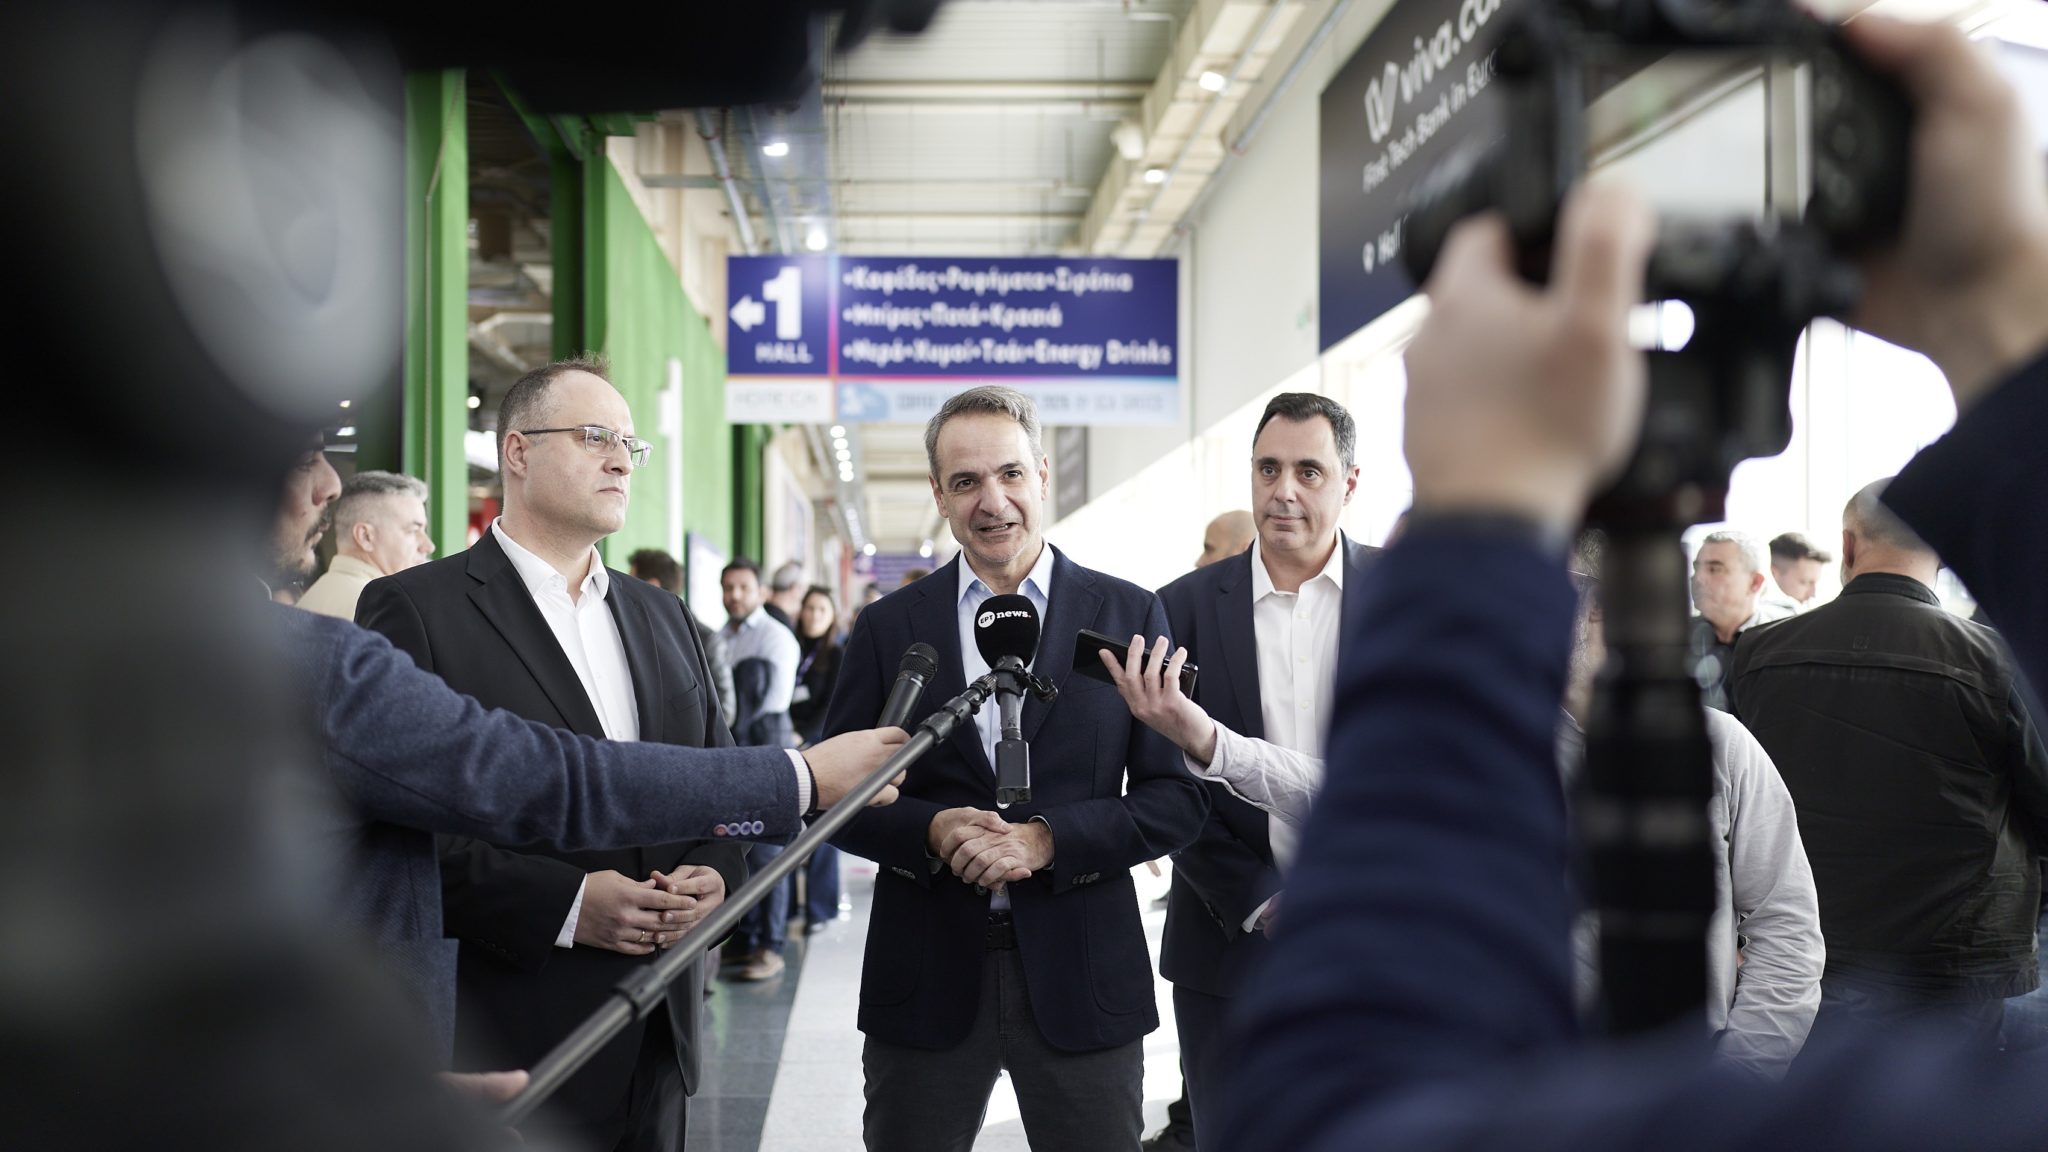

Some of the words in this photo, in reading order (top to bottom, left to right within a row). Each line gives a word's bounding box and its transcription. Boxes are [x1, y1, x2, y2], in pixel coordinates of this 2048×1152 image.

[1401, 0, 1501, 104] viva.co
[1416, 92, 1451, 145] Bank
[1450, 82, 1467, 114] in
[762, 266, 801, 339] 1
[755, 342, 814, 364] HALL
[1106, 339, 1172, 365] Drinks
